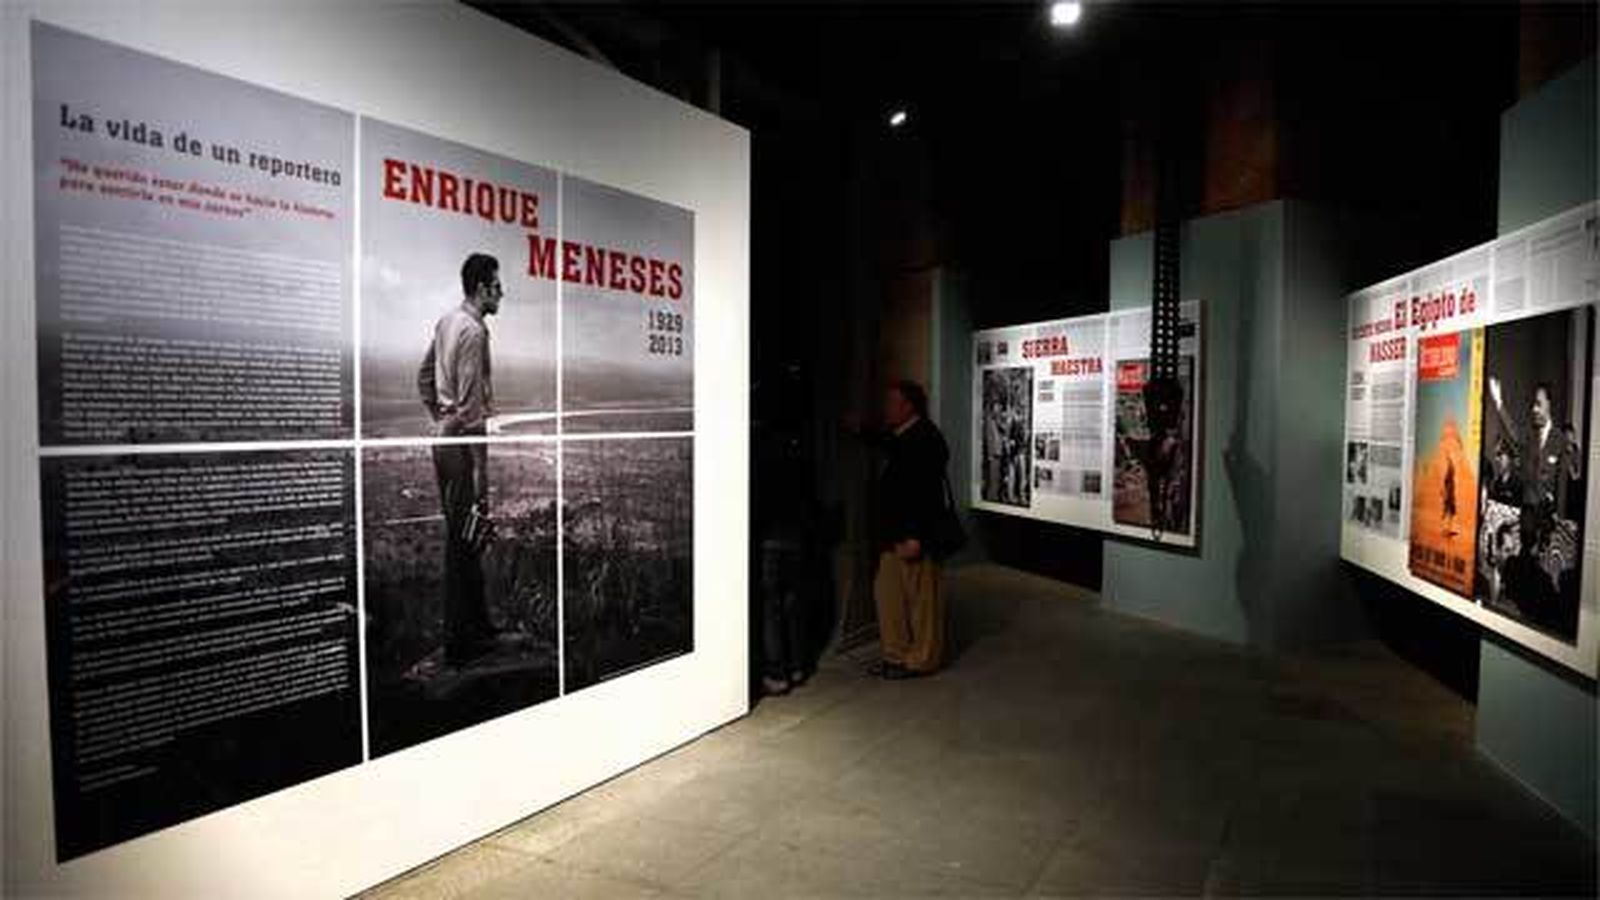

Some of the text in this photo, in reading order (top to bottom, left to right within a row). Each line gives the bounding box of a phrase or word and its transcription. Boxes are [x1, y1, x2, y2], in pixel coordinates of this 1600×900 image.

[60, 103, 341, 187] La vida de un reportero
[382, 157, 539, 229] ENRIQUE
[527, 234, 684, 301] MENESES
[649, 309, 683, 335] 1929
[1411, 291, 1456, 332] Egipto
[1460, 287, 1476, 316] de
[649, 334, 683, 357] 2013
[1021, 335, 1068, 360] SIERRA
[1050, 356, 1103, 376] MAESTRA
